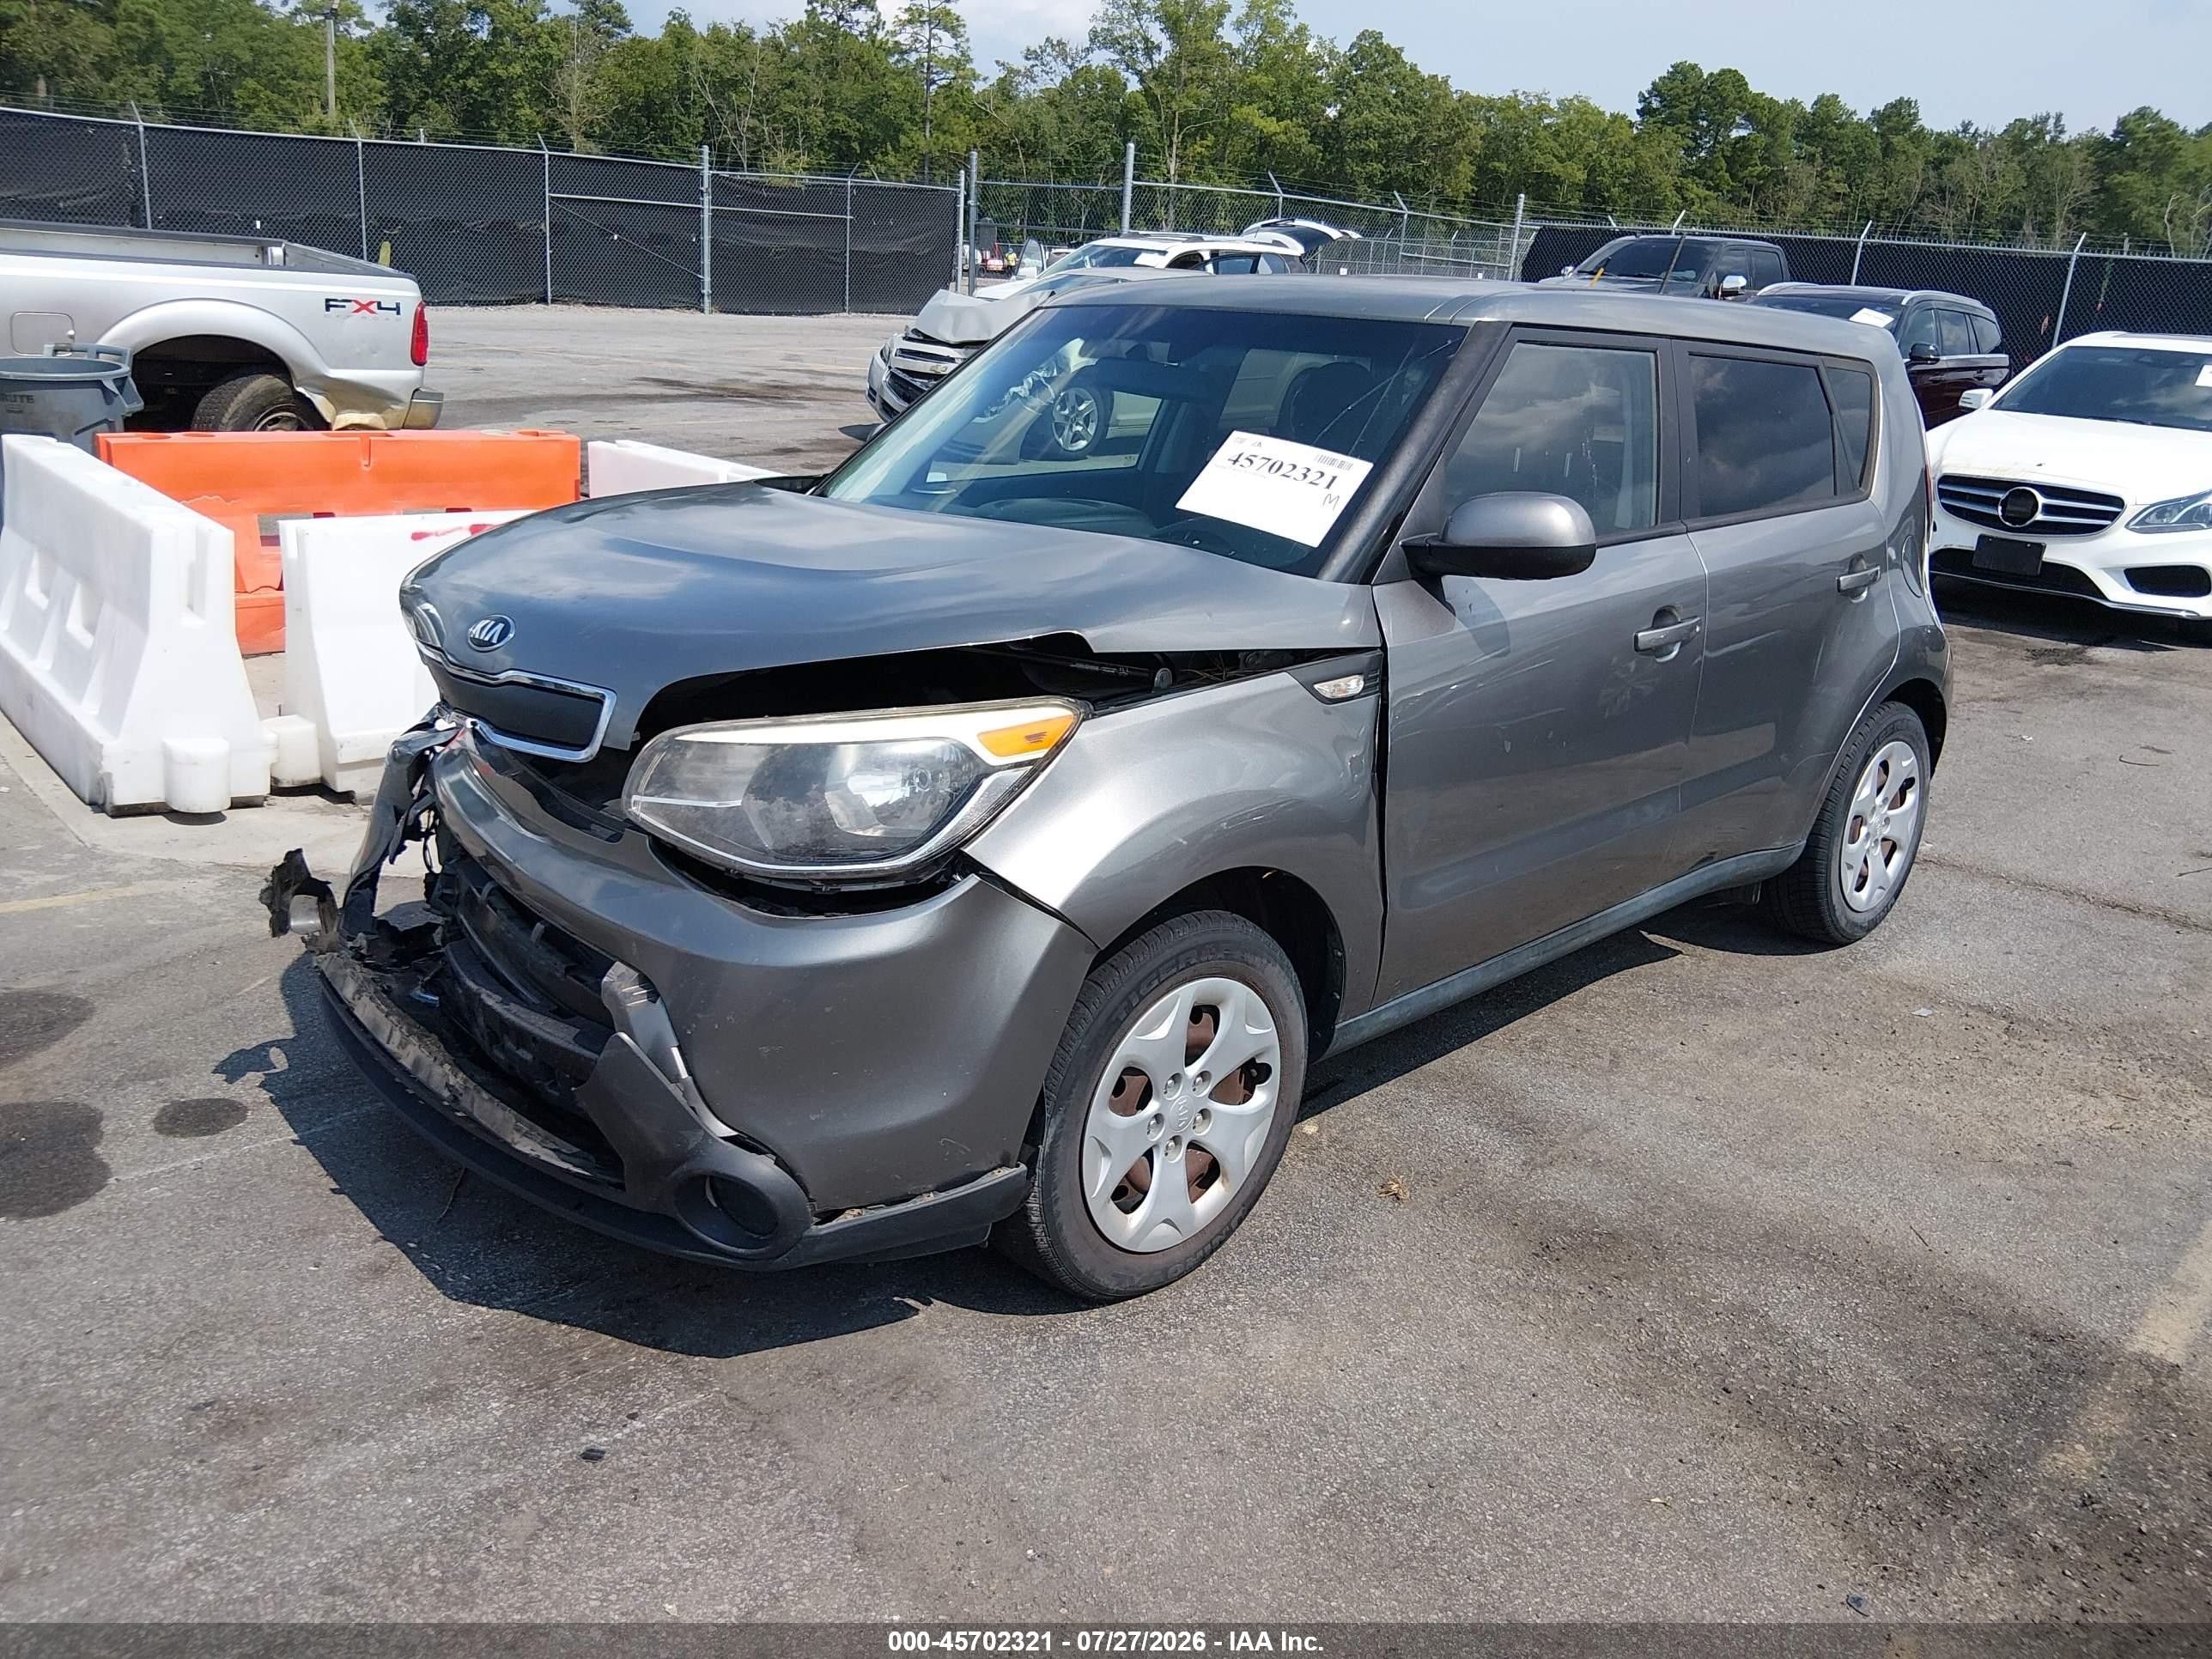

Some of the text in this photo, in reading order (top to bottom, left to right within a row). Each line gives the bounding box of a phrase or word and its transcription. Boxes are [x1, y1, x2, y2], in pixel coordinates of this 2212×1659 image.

[325, 298, 401, 315] FX4
[1228, 452, 1338, 489] 45702321
[1322, 493, 1340, 511] M
[470, 619, 505, 644] KIA
